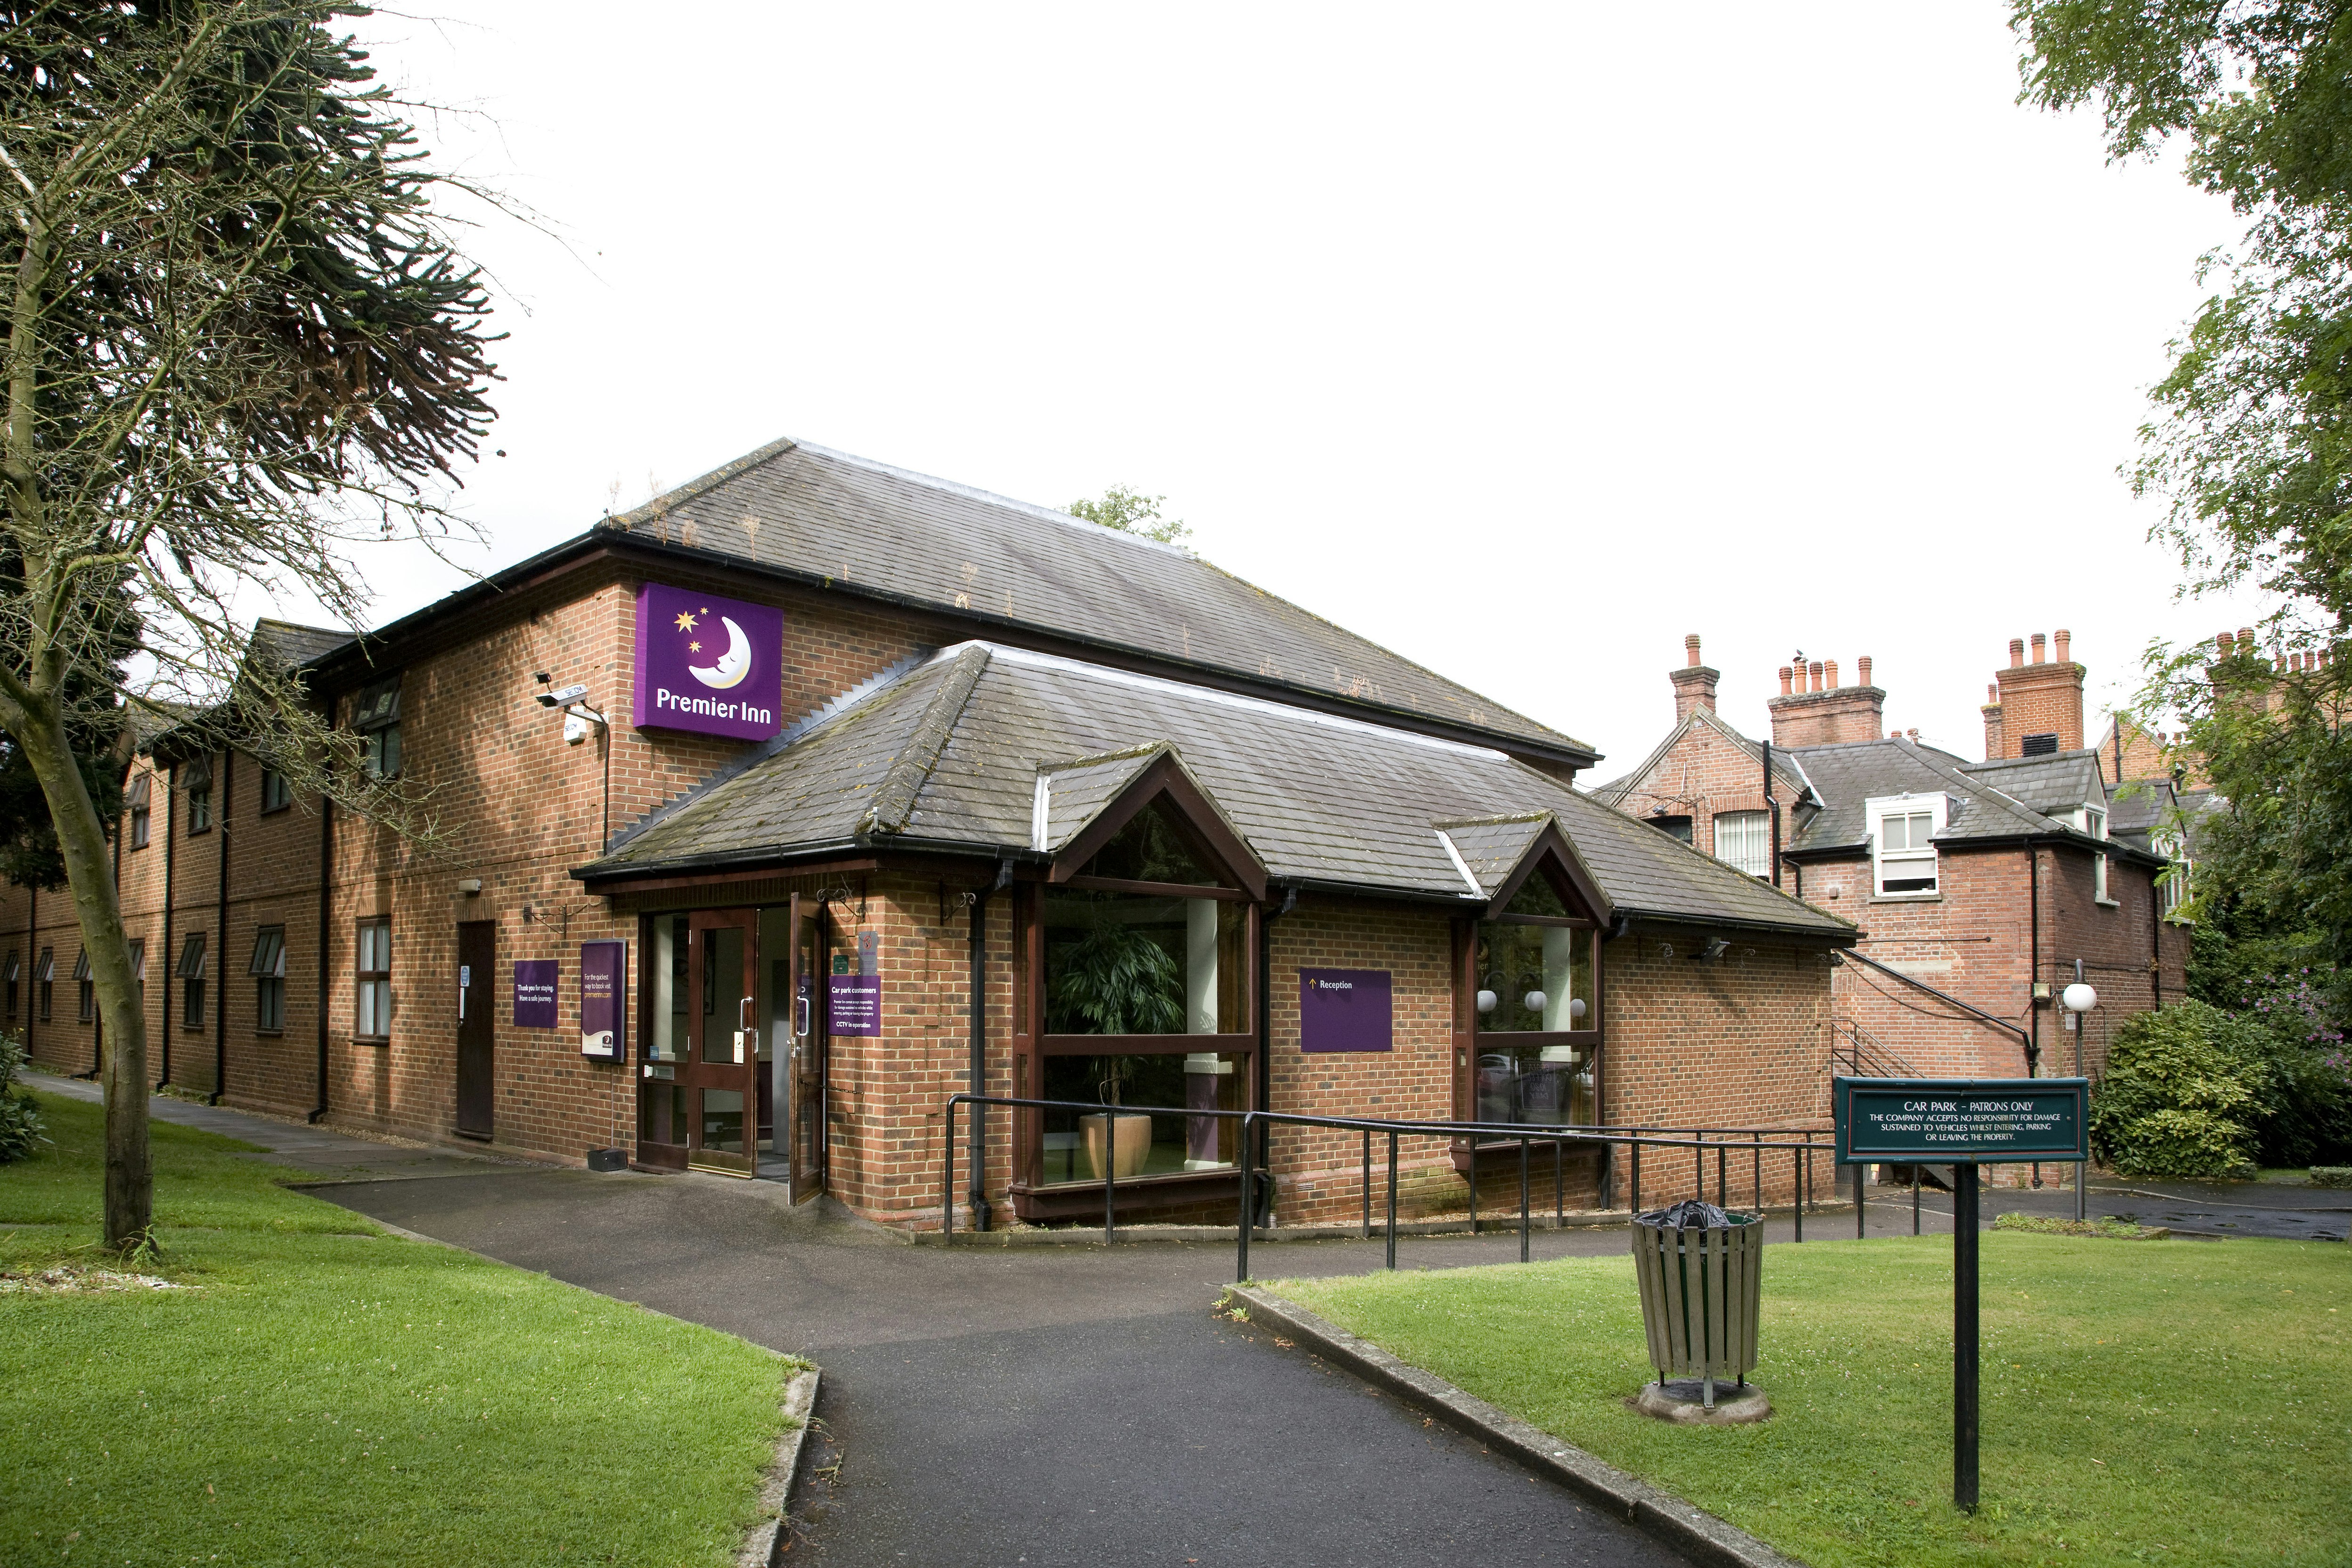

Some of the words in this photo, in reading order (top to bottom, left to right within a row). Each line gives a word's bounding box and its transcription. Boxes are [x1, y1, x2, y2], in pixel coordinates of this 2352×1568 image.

[657, 688, 738, 719] Premier
[742, 702, 771, 724] Inn
[596, 973, 609, 981] quickest
[1320, 980, 1352, 991] Reception
[841, 987, 851, 995] park
[538, 995, 552, 1004] journey.
[1904, 1102, 1927, 1111] CAR
[1931, 1102, 1957, 1111] PARK
[1970, 1102, 2008, 1111] PATRONS
[2011, 1102, 2033, 1111] ONLY
